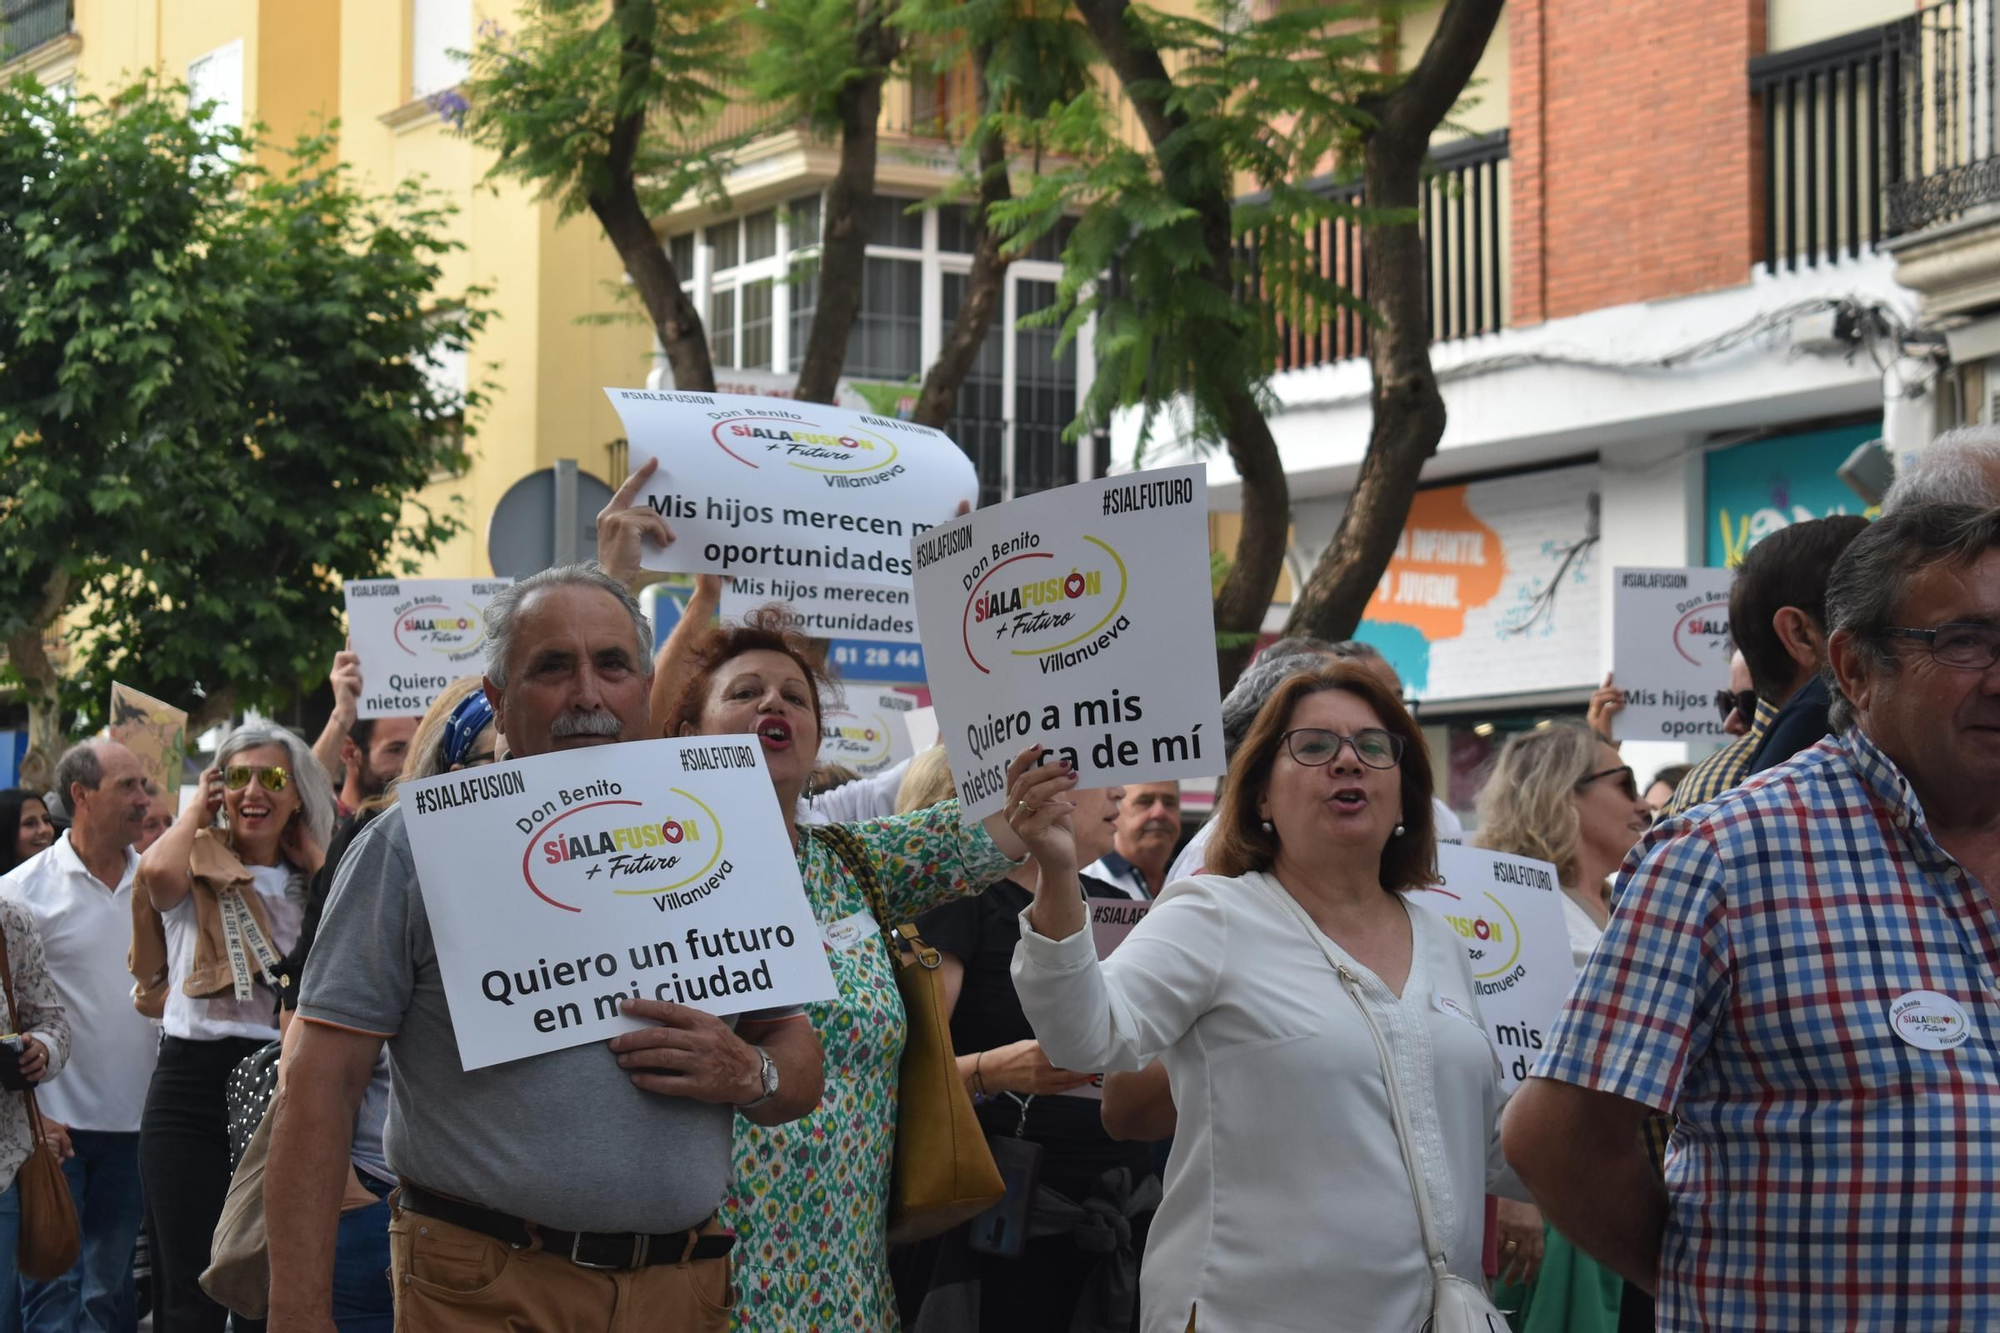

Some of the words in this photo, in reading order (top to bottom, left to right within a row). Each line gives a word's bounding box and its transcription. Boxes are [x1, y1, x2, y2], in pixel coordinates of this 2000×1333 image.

[621, 391, 715, 405] #SIALAFUSION
[707, 409, 742, 421] Don
[745, 408, 802, 420] Benito
[859, 415, 939, 438] #SIALFUTURO
[785, 442, 854, 462] Futuro
[823, 462, 906, 489] Villanueva
[1102, 477, 1193, 516] #SIALFUTURO
[647, 494, 697, 518] Mis
[706, 496, 773, 528] hijos
[783, 510, 903, 537] merecen
[703, 541, 913, 576] oportunidades
[916, 524, 973, 570] #SIALAFUSION
[962, 555, 989, 592] Don
[991, 531, 1040, 562] Benito
[351, 583, 400, 597] #SIALAFUSION
[731, 577, 766, 596] Mis
[770, 578, 818, 603] hijos
[824, 588, 909, 604] merecen
[1622, 573, 1687, 589] #SIALAFUSION
[394, 601, 413, 615] Don
[414, 595, 443, 604] Benito
[1676, 597, 1702, 614] Don
[430, 632, 463, 643] Futuro
[1011, 610, 1076, 639] Futuro
[1039, 614, 1131, 674] Villanueva
[895, 650, 920, 667] 44
[389, 674, 447, 691] Quiero
[366, 694, 421, 710] nietos
[1624, 690, 1656, 706] Mis
[1662, 690, 1707, 711] hijos
[966, 709, 1031, 760] Quiero
[1041, 705, 1060, 731] a
[1074, 689, 1143, 728] mis
[680, 745, 757, 772] #SIALFUTURO
[961, 767, 1004, 806] nietos
[1092, 734, 1139, 770] de
[1152, 724, 1204, 764] mí
[415, 770, 527, 815] #SIALAFUSION
[515, 798, 557, 835] Don
[558, 779, 623, 807] Benito
[609, 853, 682, 880] Futuro
[1493, 861, 1552, 892] #SIALFUTURO
[653, 859, 735, 913] Villanueva
[233, 952, 249, 987] RESPECT
[481, 952, 618, 1006] Quiero
[629, 940, 678, 971] un
[685, 922, 796, 961] futuro
[533, 1001, 583, 1034] en
[655, 959, 774, 1005] ciudad
[1496, 1021, 1543, 1050] mis
[1939, 1031, 1967, 1044] Villanueva
[1512, 1055, 1535, 1082] d
